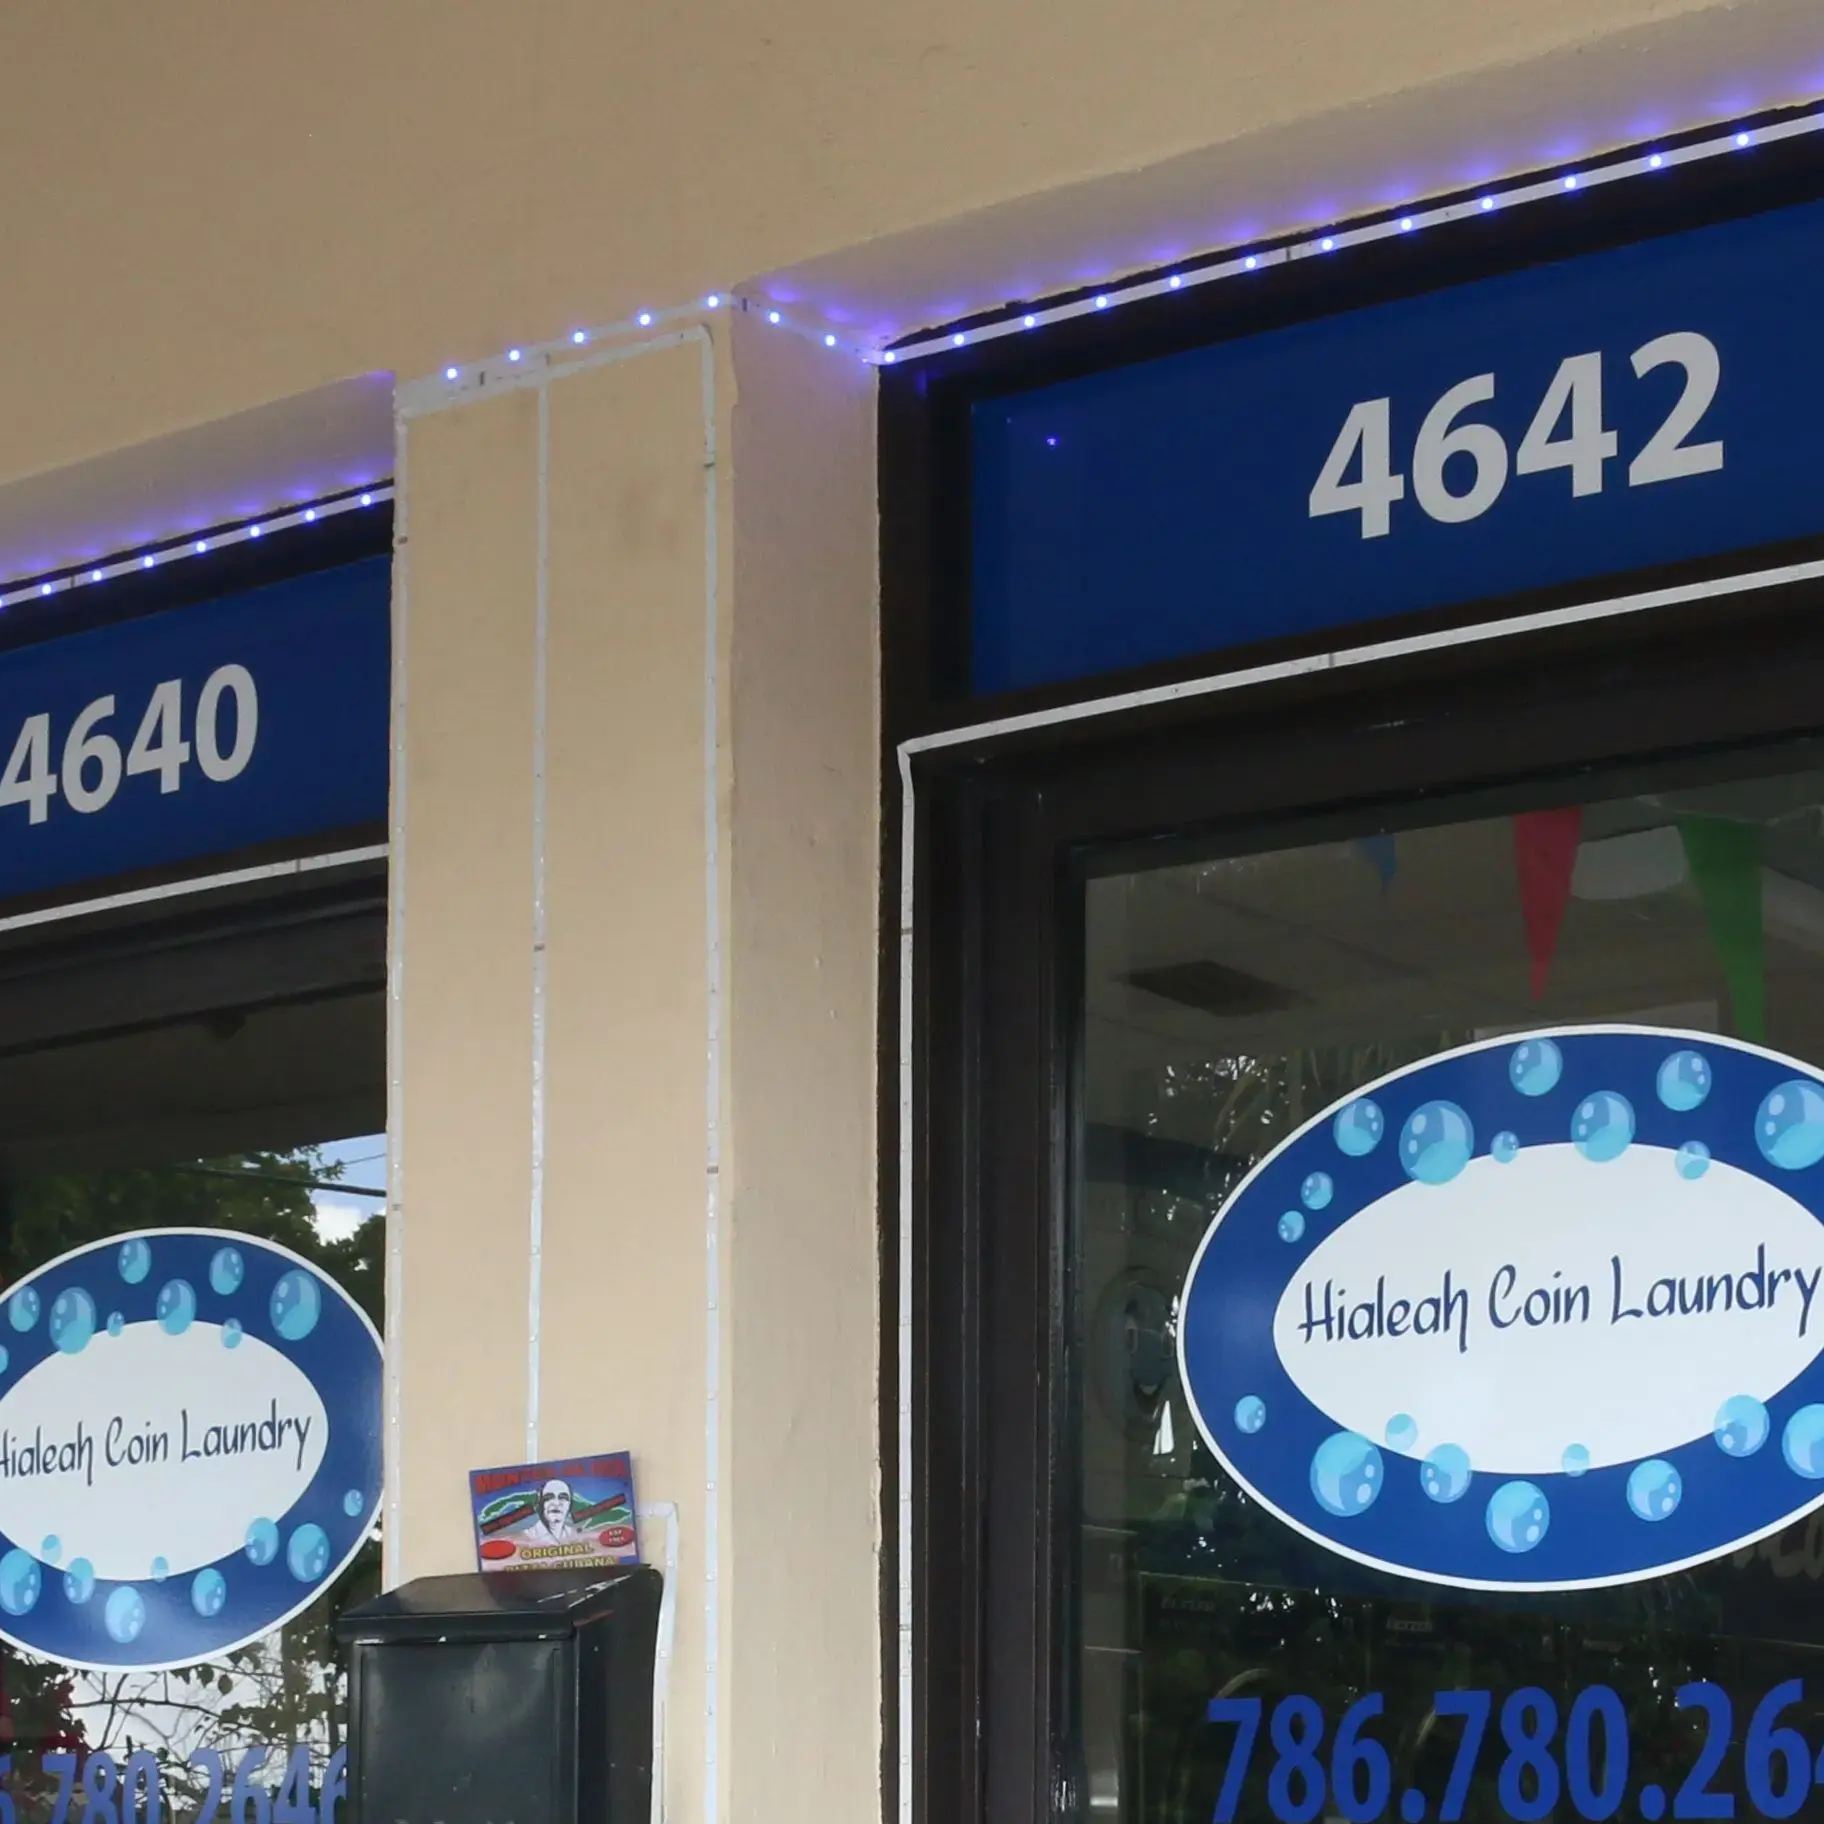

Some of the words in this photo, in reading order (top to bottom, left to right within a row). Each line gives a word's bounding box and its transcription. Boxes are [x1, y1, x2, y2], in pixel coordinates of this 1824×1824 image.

[1309, 330, 1725, 539] 4642
[1298, 1268, 1469, 1353] Hialeah
[1487, 1264, 1591, 1330] Coin
[1611, 1242, 1824, 1337] Laundry
[105, 1405, 169, 1467] Coin
[180, 1397, 313, 1471] Laundry
[519, 1541, 595, 1561] ORIGINAL
